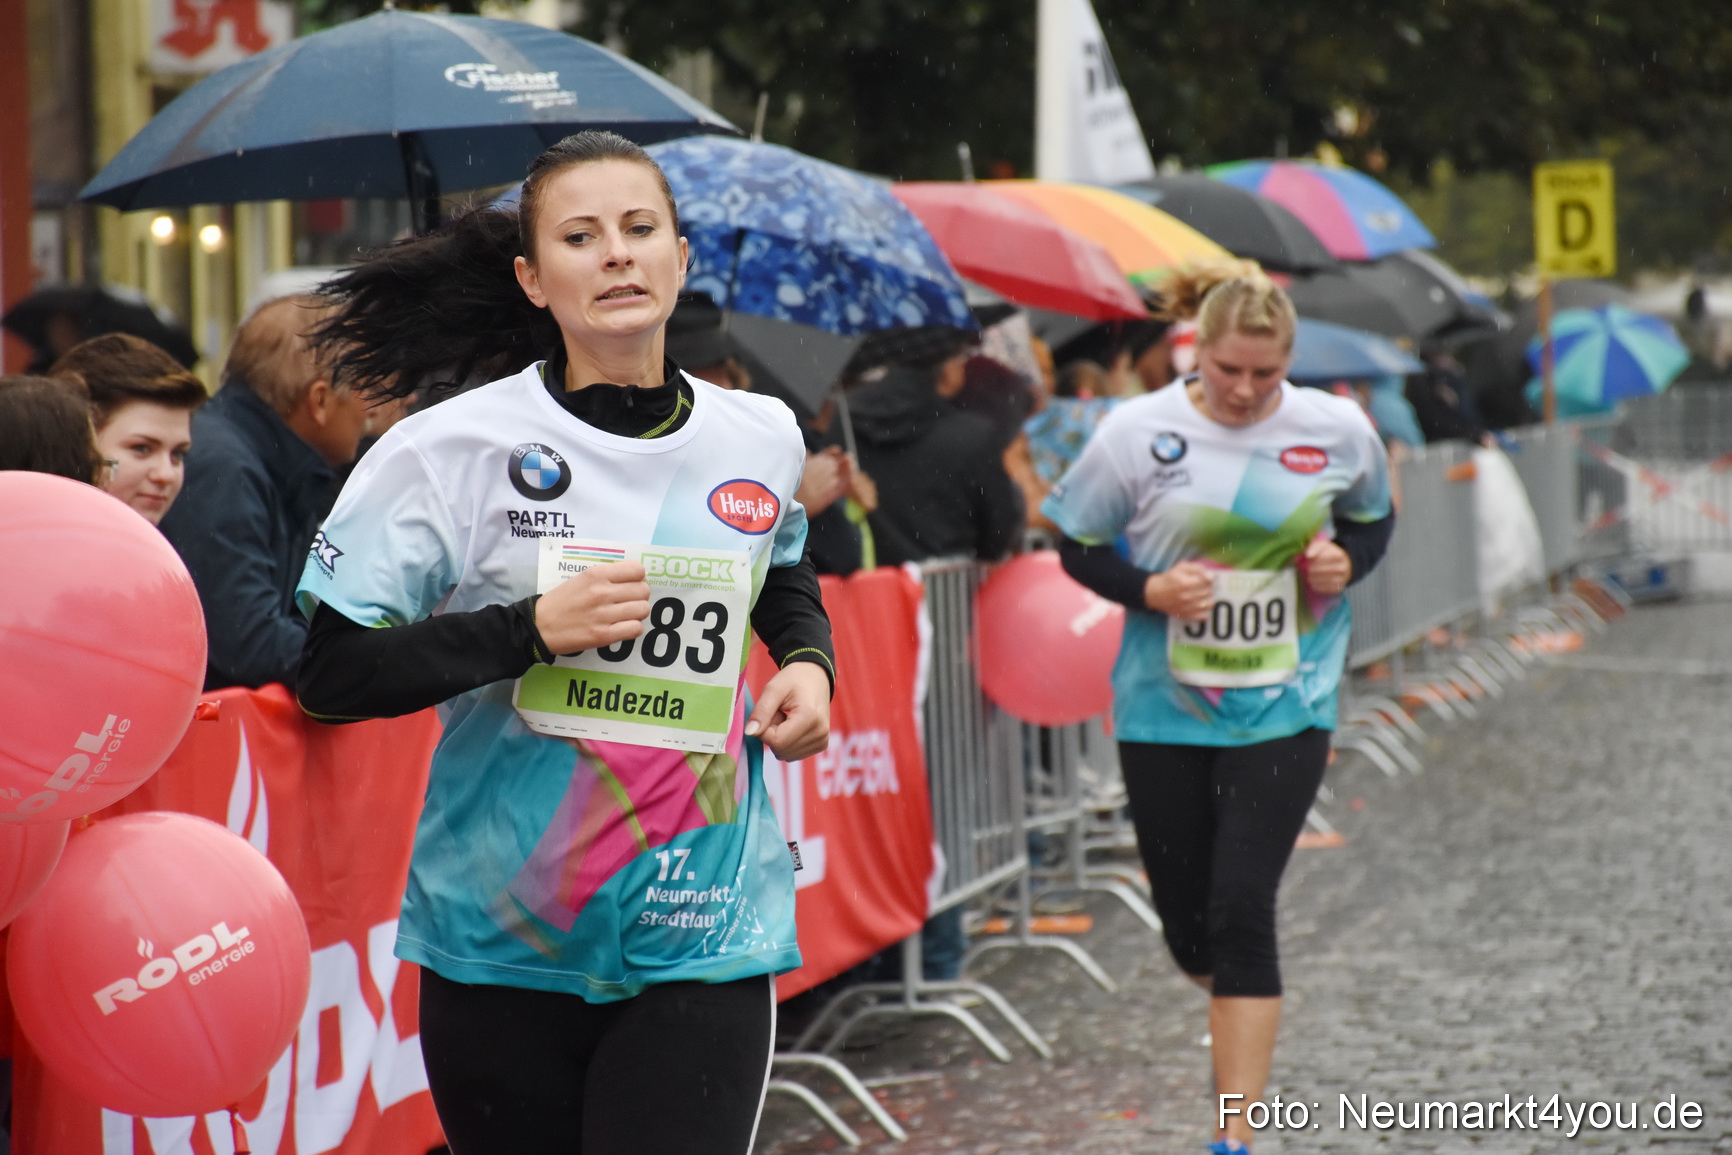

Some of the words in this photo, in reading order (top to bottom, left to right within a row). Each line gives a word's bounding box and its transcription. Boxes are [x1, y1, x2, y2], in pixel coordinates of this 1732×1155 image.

[1556, 199, 1594, 252] D
[507, 510, 575, 528] PARTL
[719, 493, 775, 521] Hervis
[511, 525, 575, 539] Neumarkt
[558, 561, 592, 574] Neue
[641, 553, 736, 583] BOCK
[566, 678, 685, 720] Nadezda
[655, 848, 695, 881] 17.
[93, 921, 250, 1016] RÖDL
